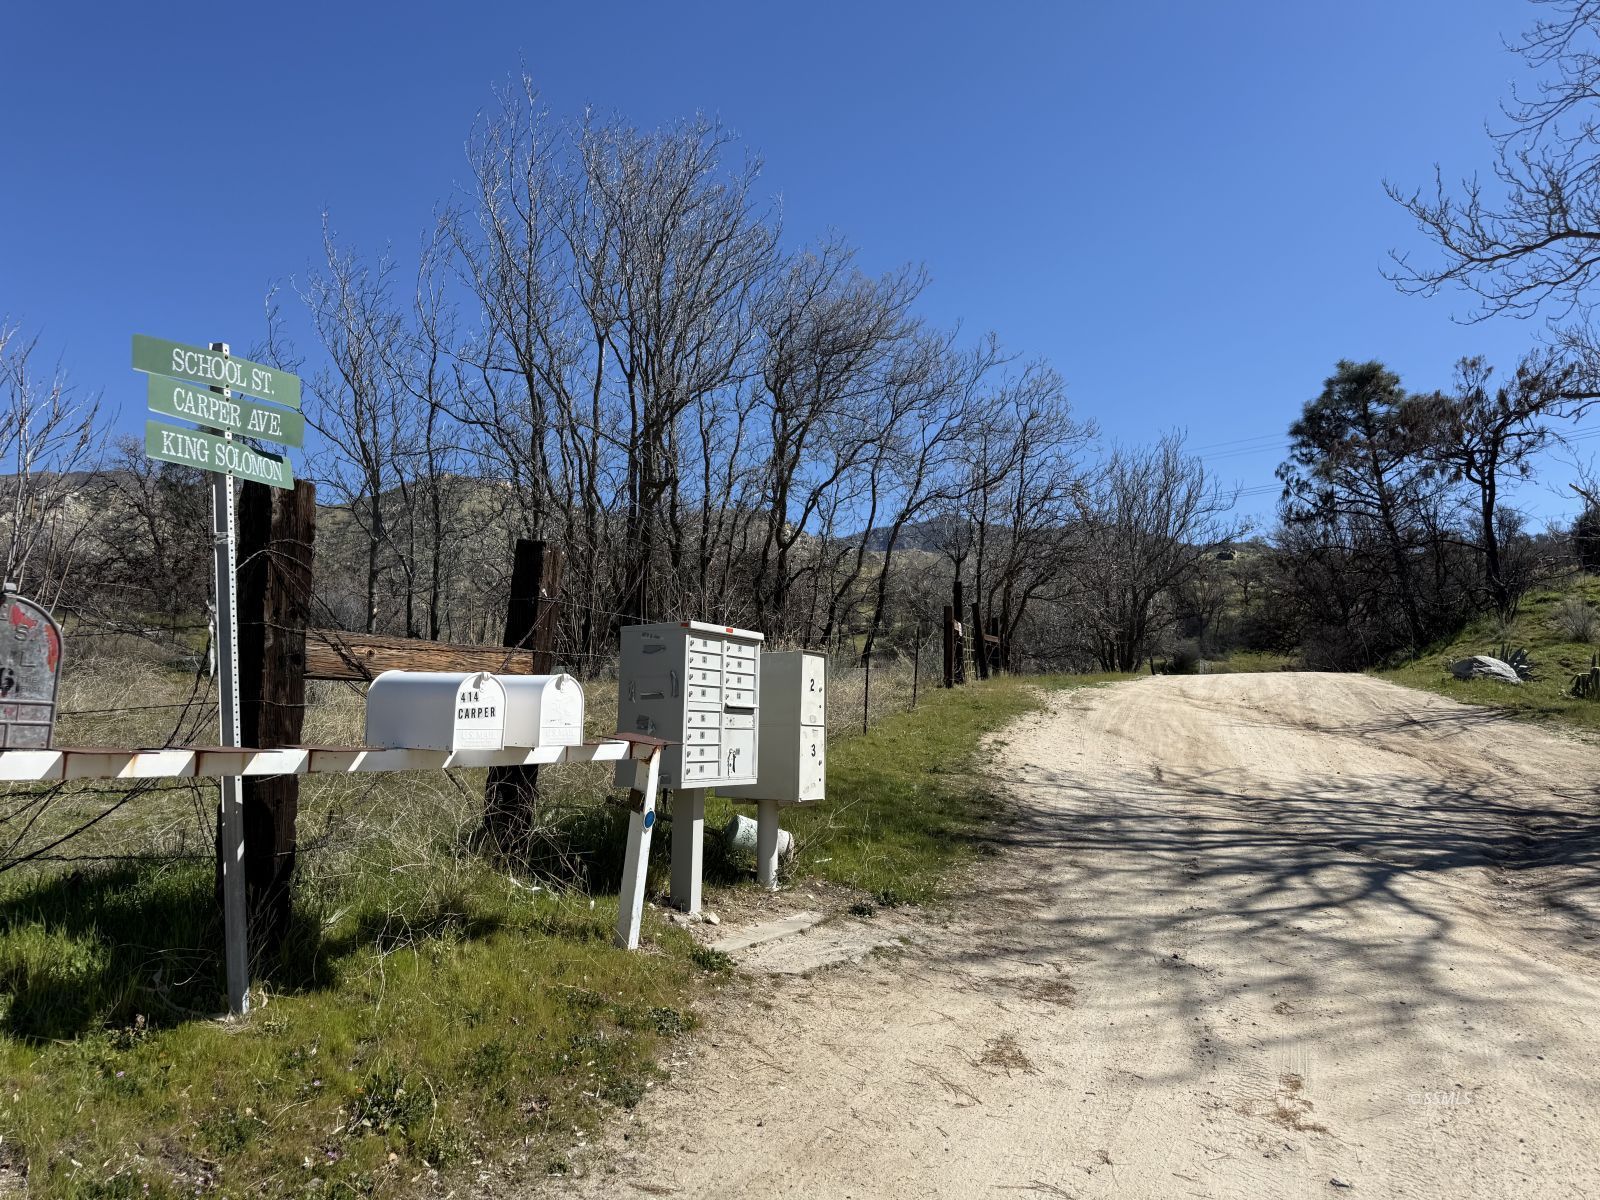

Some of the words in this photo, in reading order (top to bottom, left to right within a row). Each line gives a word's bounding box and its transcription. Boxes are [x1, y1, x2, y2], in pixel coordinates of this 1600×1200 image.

[172, 348, 247, 387] SCHOOL
[251, 368, 275, 395] ST.
[173, 388, 242, 428] CARPER
[247, 409, 283, 436] AVE.
[161, 430, 210, 463] KING
[215, 443, 283, 482] SOLOMON
[810, 678, 815, 692] 2
[460, 691, 479, 703] 414
[458, 706, 496, 720] CARPER
[811, 744, 816, 757] 3
